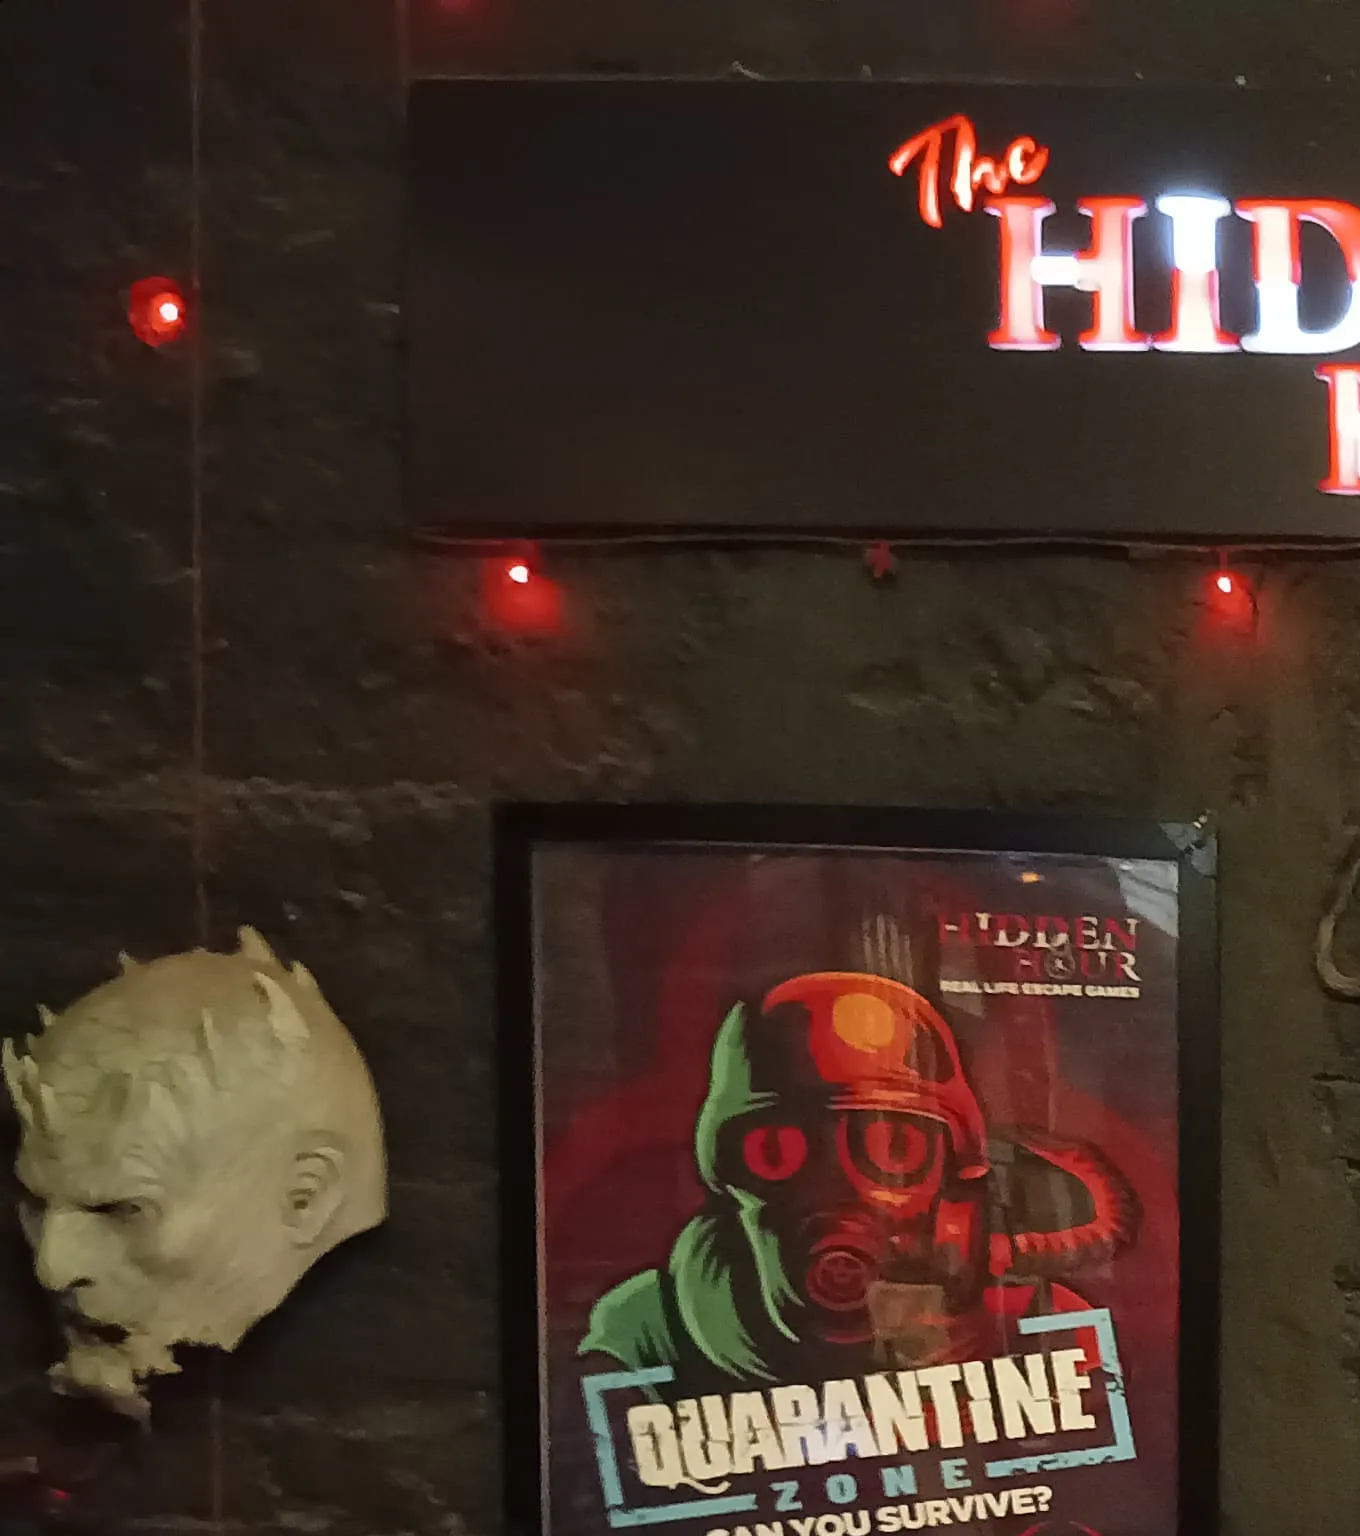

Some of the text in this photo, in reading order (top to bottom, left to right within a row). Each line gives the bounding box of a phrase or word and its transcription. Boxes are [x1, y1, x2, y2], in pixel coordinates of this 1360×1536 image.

[889, 114, 1048, 227] The
[938, 912, 1141, 951] HIDDEN
[1015, 950, 1142, 982] HOUR
[626, 1348, 1096, 1494] QUARANTINE
[769, 1459, 972, 1511] ZONE
[877, 1485, 1053, 1533] SURVIVE?
